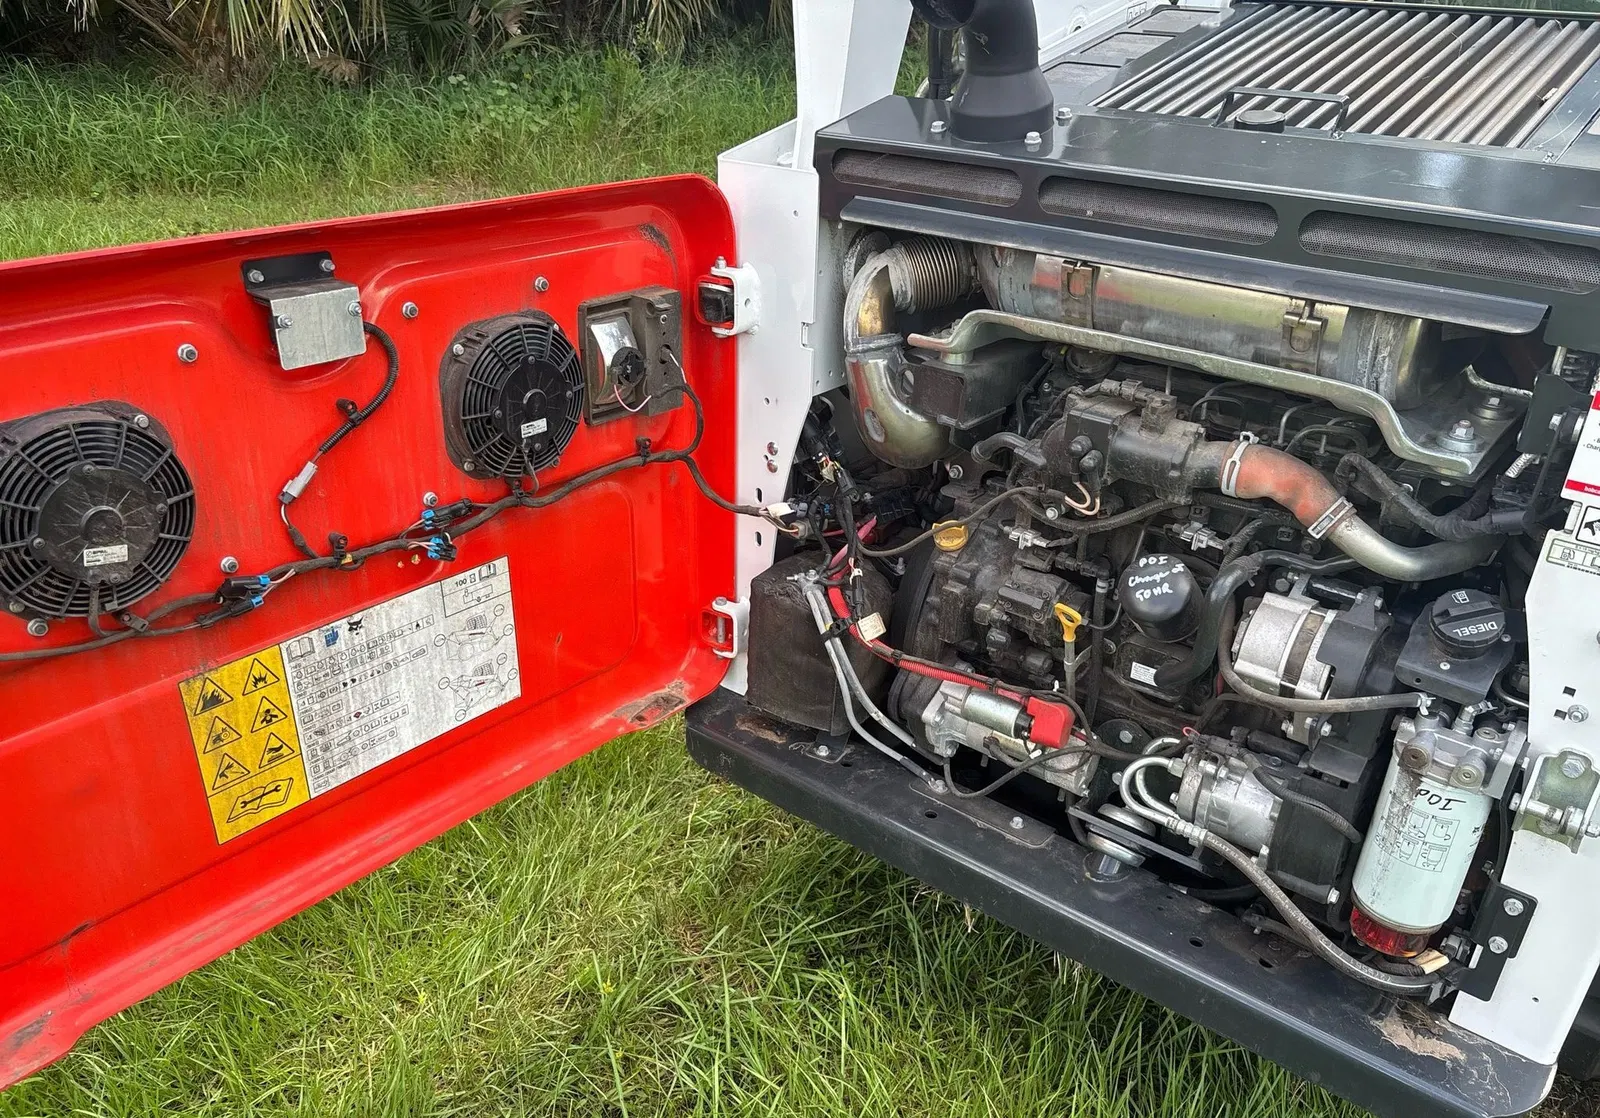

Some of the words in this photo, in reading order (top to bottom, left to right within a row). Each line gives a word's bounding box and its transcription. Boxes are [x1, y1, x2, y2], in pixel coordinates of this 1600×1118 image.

[455, 578, 467, 587] 100
[1128, 570, 1170, 587] Change
[1452, 621, 1498, 637] DIESEL
